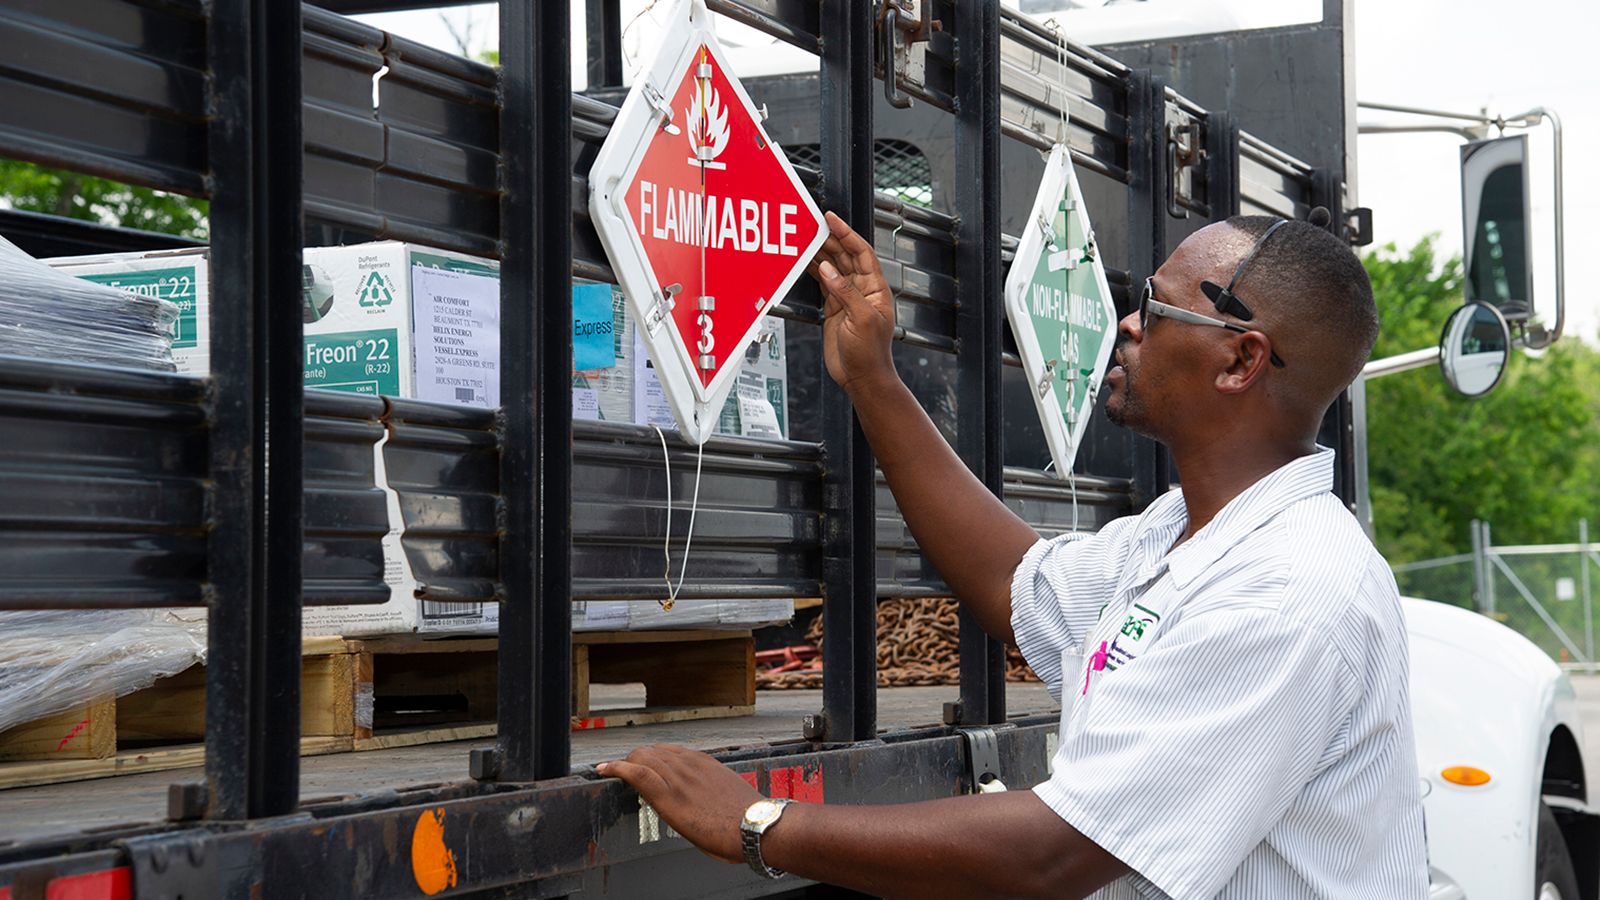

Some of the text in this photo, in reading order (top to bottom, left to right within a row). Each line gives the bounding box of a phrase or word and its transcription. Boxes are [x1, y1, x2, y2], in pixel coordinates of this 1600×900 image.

[640, 181, 798, 256] FLAMMABLE
[168, 276, 191, 298] 22
[1033, 283, 1102, 332] NON-FLAMMABLE
[575, 319, 613, 340] Express
[697, 314, 715, 354] 3
[365, 338, 390, 361] 22
[1060, 330, 1080, 365] GAS
[365, 362, 391, 376] (R-22)
